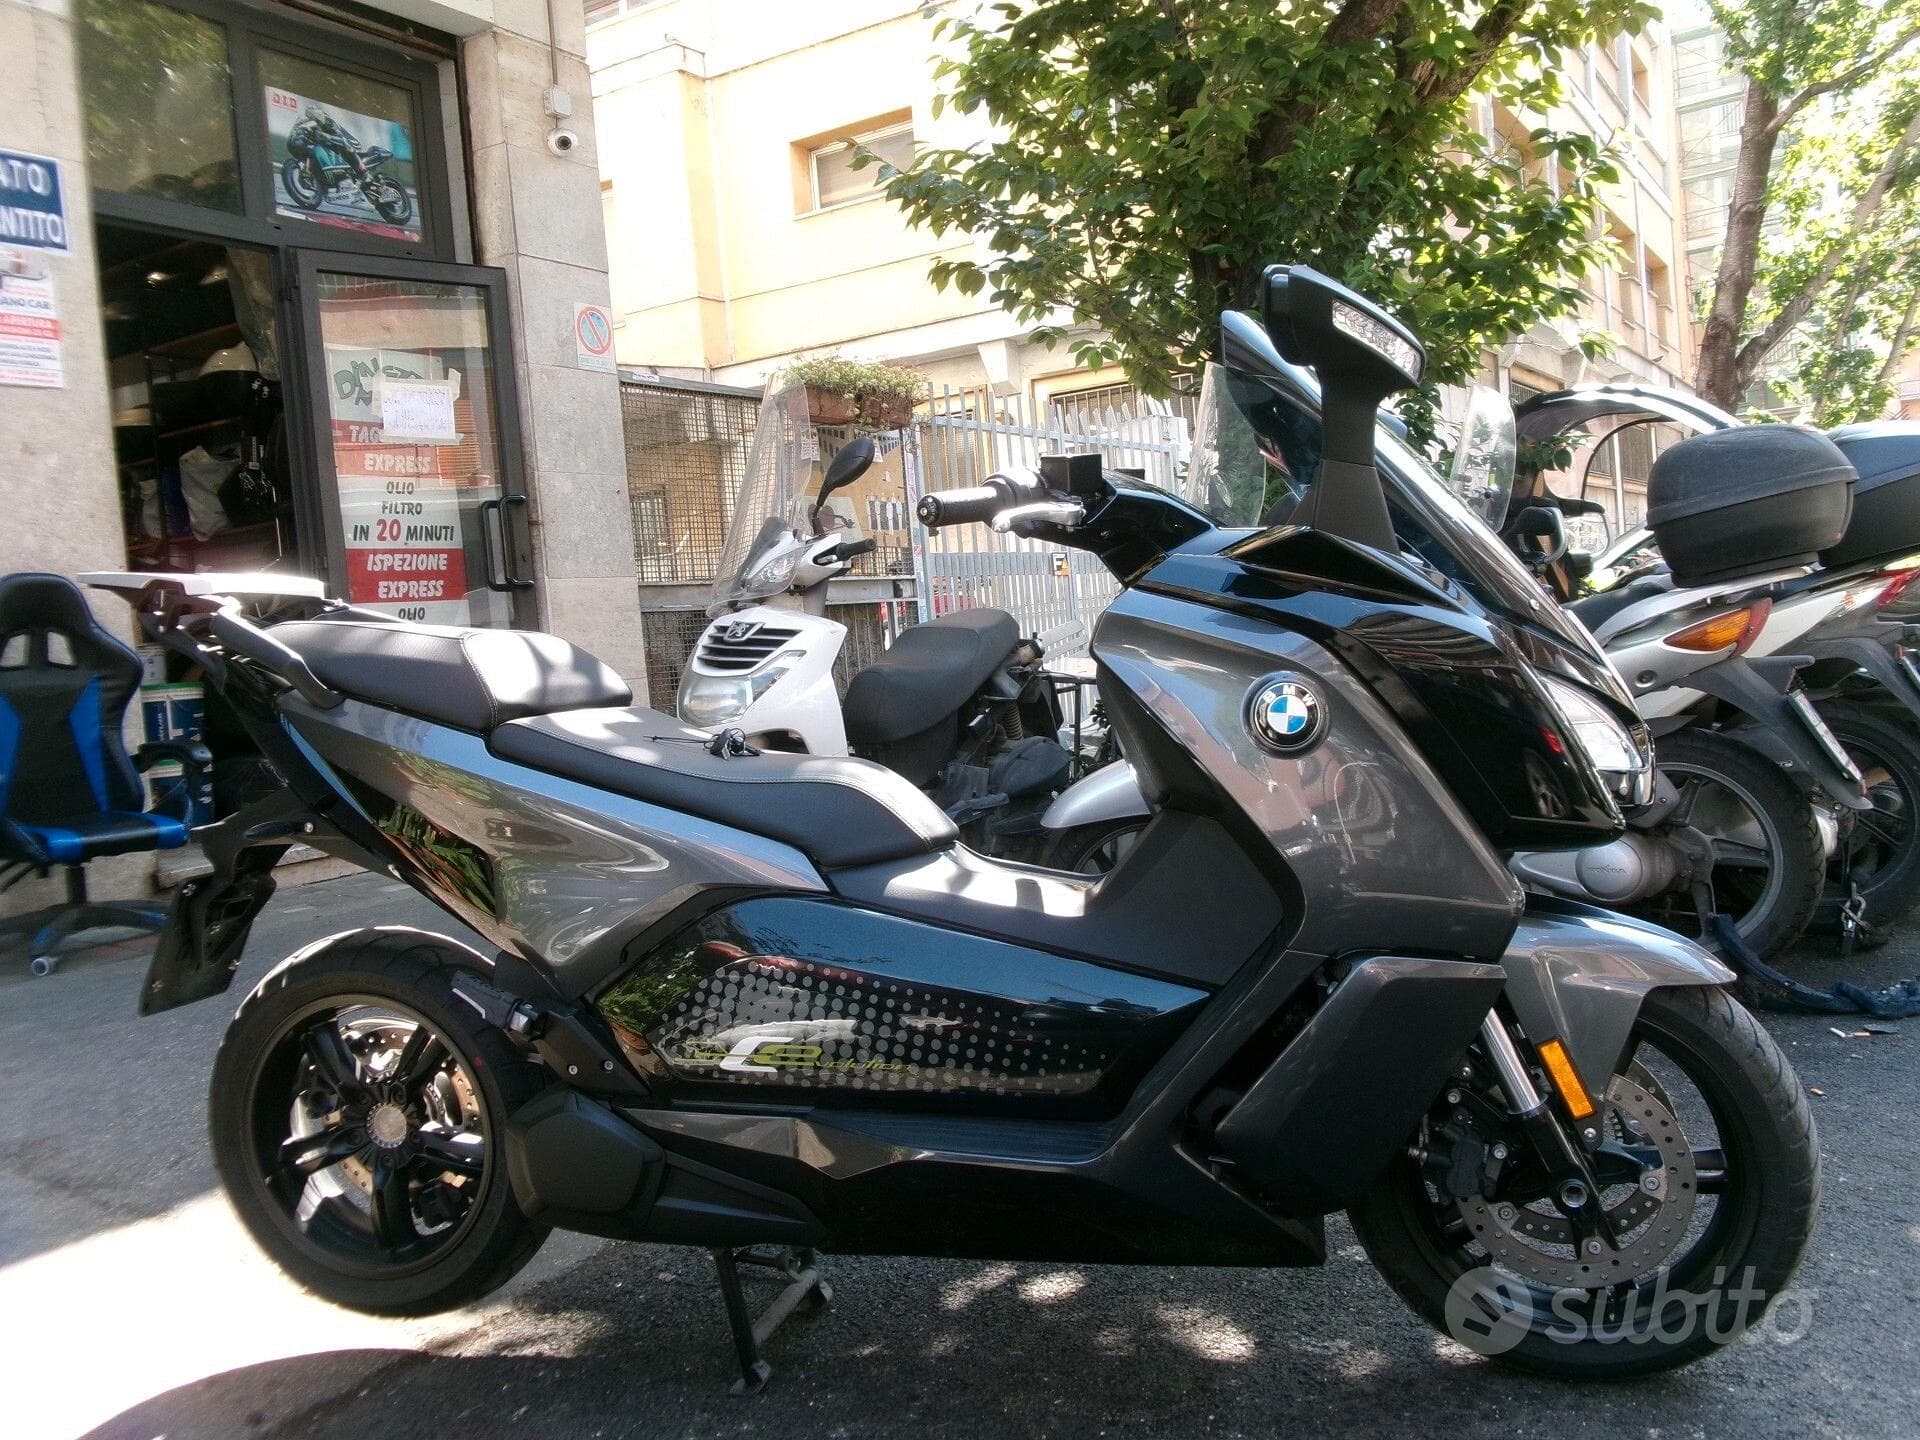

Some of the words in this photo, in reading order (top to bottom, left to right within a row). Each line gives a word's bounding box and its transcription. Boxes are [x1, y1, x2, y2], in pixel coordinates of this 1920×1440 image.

[363, 453, 431, 474] EXPRESS
[386, 481, 415, 495] OLIO
[381, 501, 423, 516] FILTRO
[353, 525, 370, 541] IN
[376, 518, 402, 541] 20
[405, 525, 455, 541] MINUTI
[367, 553, 448, 572] ISPEZIONE
[378, 580, 445, 599] EXPRESS
[398, 607, 426, 621] OLIO
[1262, 684, 1316, 706] BMW
